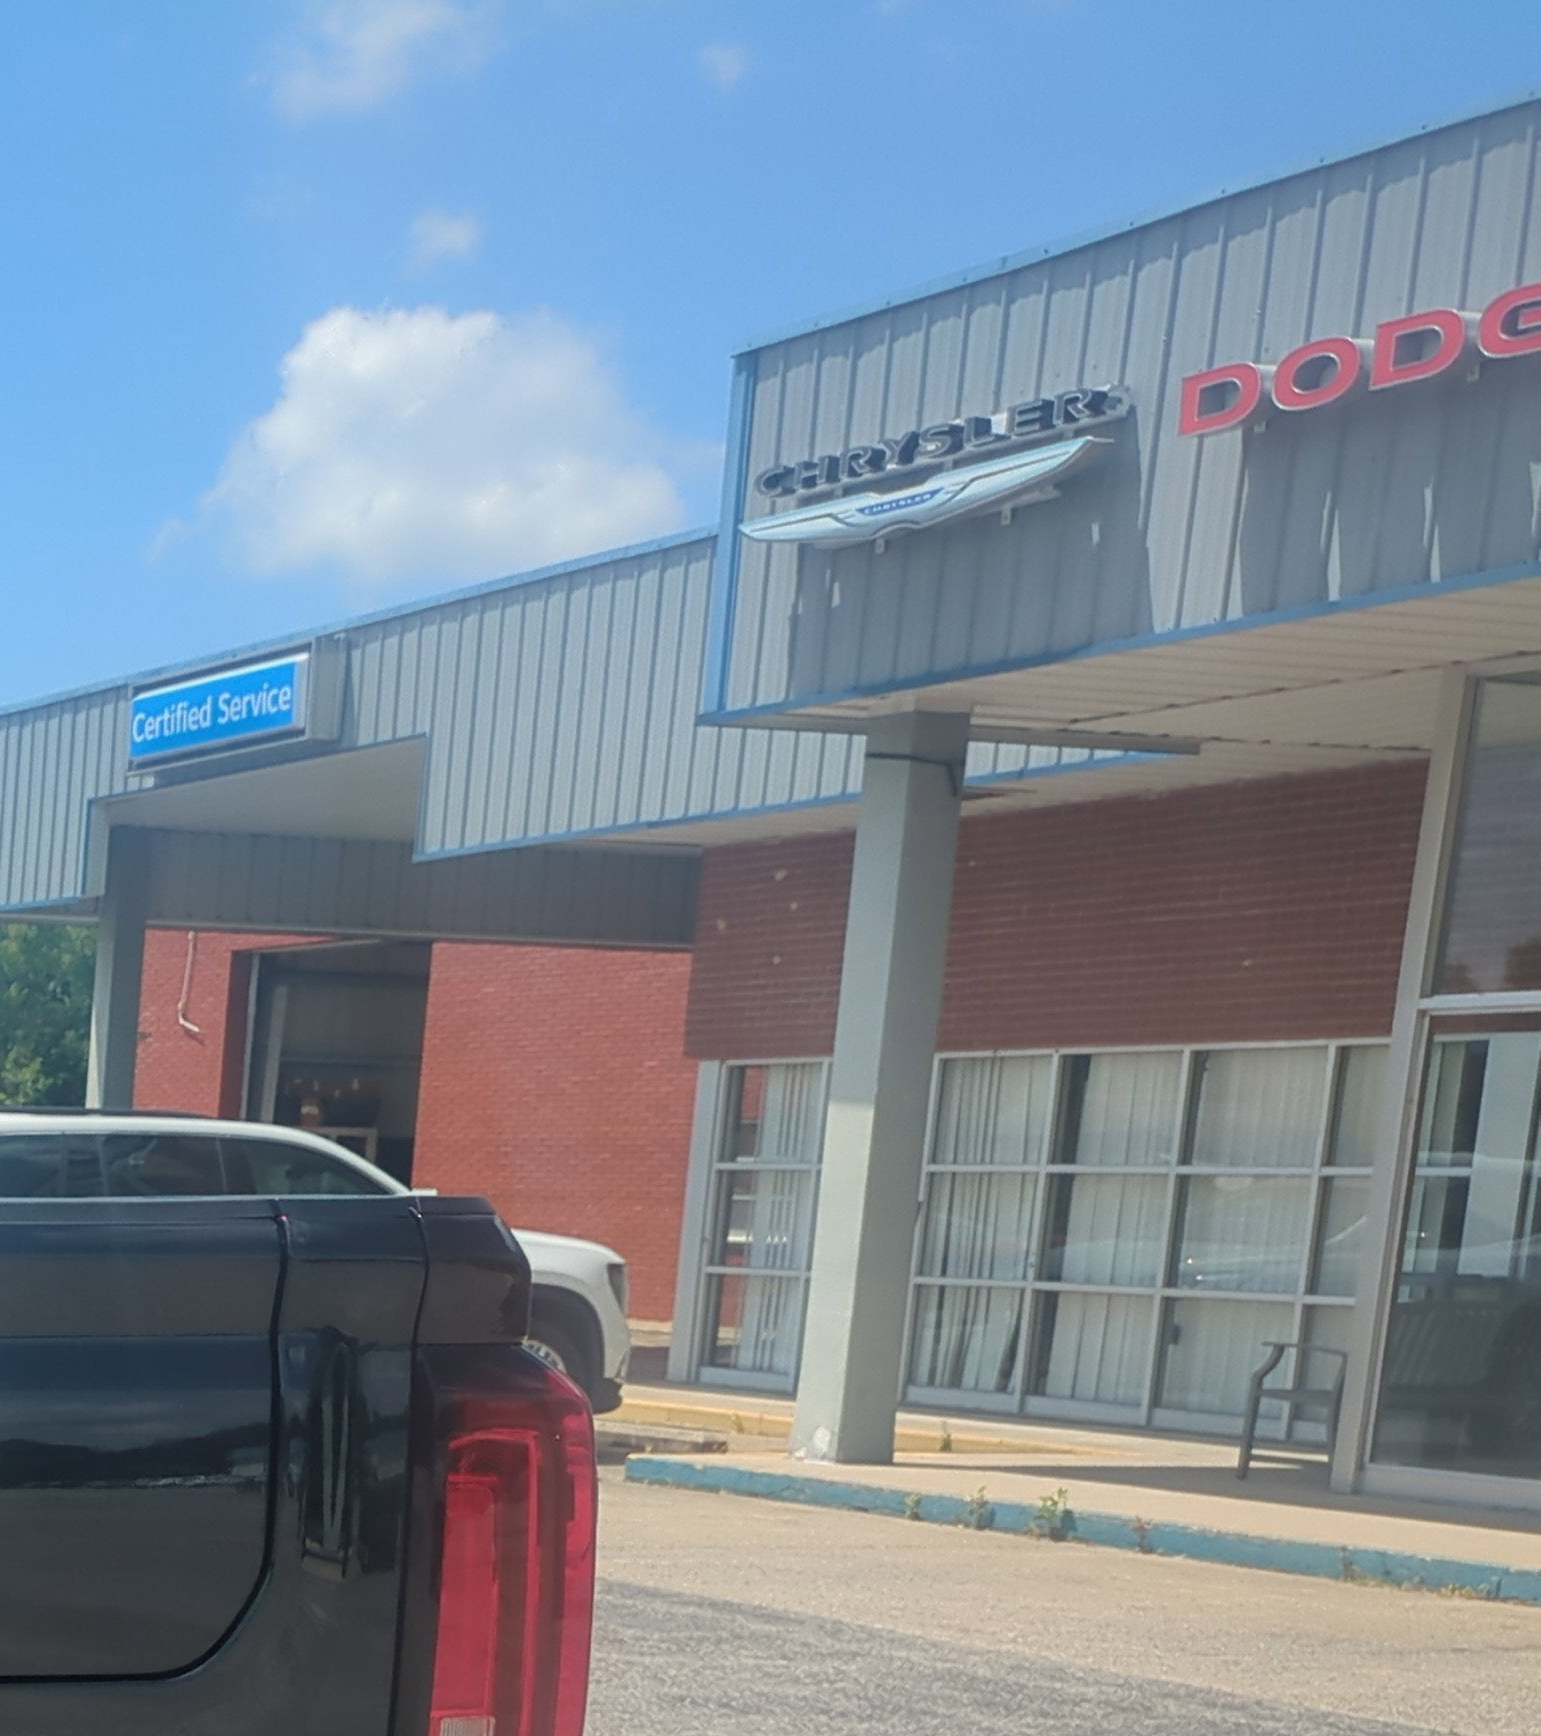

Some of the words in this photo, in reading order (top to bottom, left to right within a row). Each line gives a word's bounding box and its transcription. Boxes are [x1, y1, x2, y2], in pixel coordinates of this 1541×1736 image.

[1178, 283, 1541, 436] DODG
[756, 387, 1107, 497] CHRYSLER
[132, 695, 213, 743] Certified
[218, 683, 292, 724] Service
